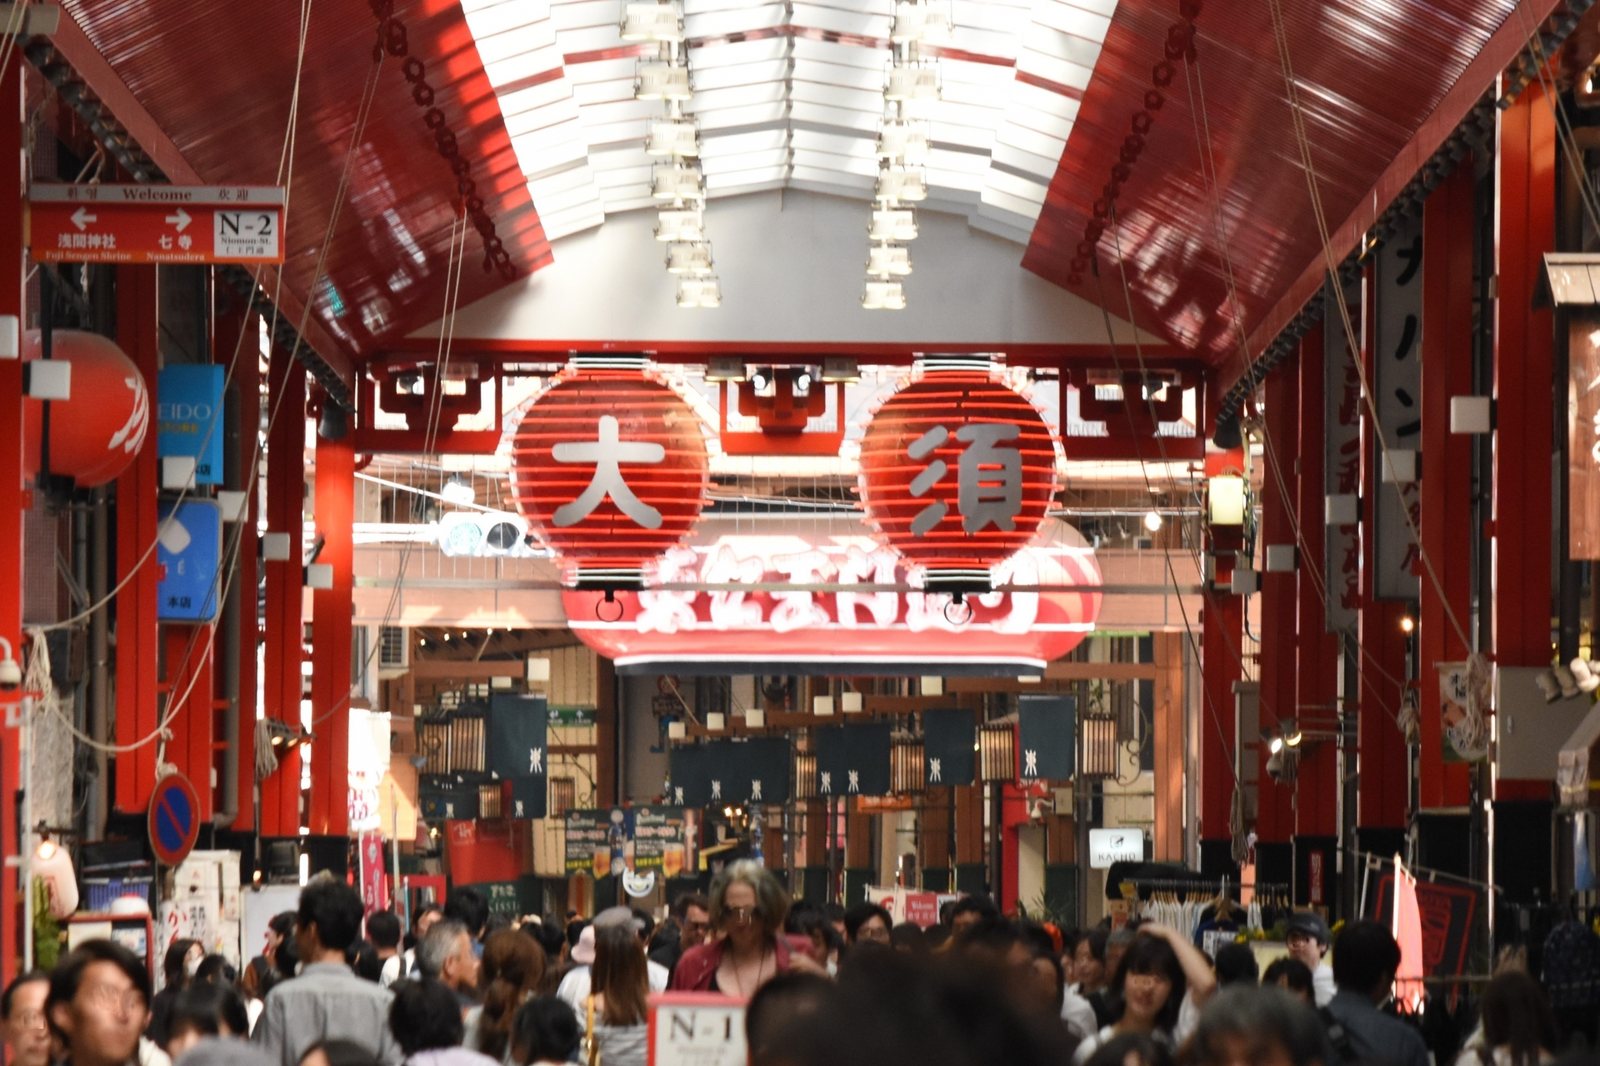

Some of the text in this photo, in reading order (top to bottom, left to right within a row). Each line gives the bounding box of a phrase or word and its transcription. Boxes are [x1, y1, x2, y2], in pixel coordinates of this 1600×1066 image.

[123, 188, 192, 200] Welcome
[218, 212, 272, 235] N-2
[58, 233, 117, 250] 浅間神社
[551, 415, 666, 529] 大
[906, 422, 1024, 537] 須
